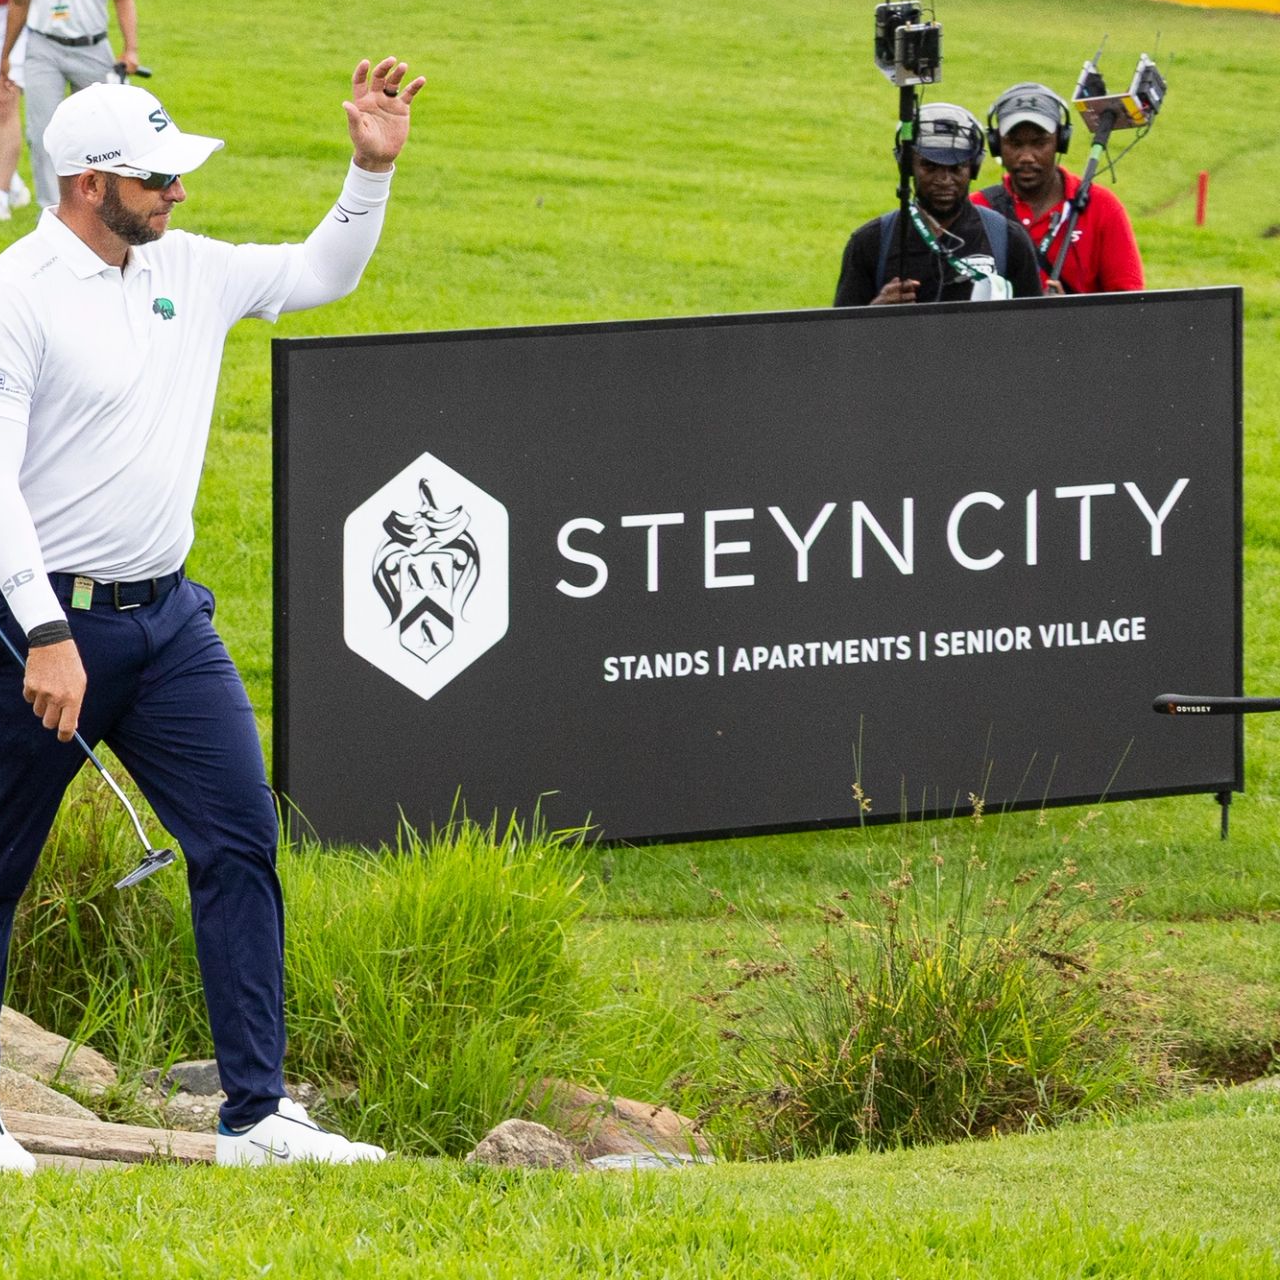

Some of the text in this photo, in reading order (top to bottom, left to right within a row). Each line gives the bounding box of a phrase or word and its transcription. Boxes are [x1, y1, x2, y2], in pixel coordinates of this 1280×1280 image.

[148, 107, 172, 133] S
[85, 149, 122, 165] SRIXON
[555, 477, 1190, 599] STEYN CITY
[2, 568, 35, 598] SG
[603, 616, 1147, 682] STANDS APARTMENTS SENIOR VILLAGE
[1176, 705, 1212, 713] ODYSSEY
